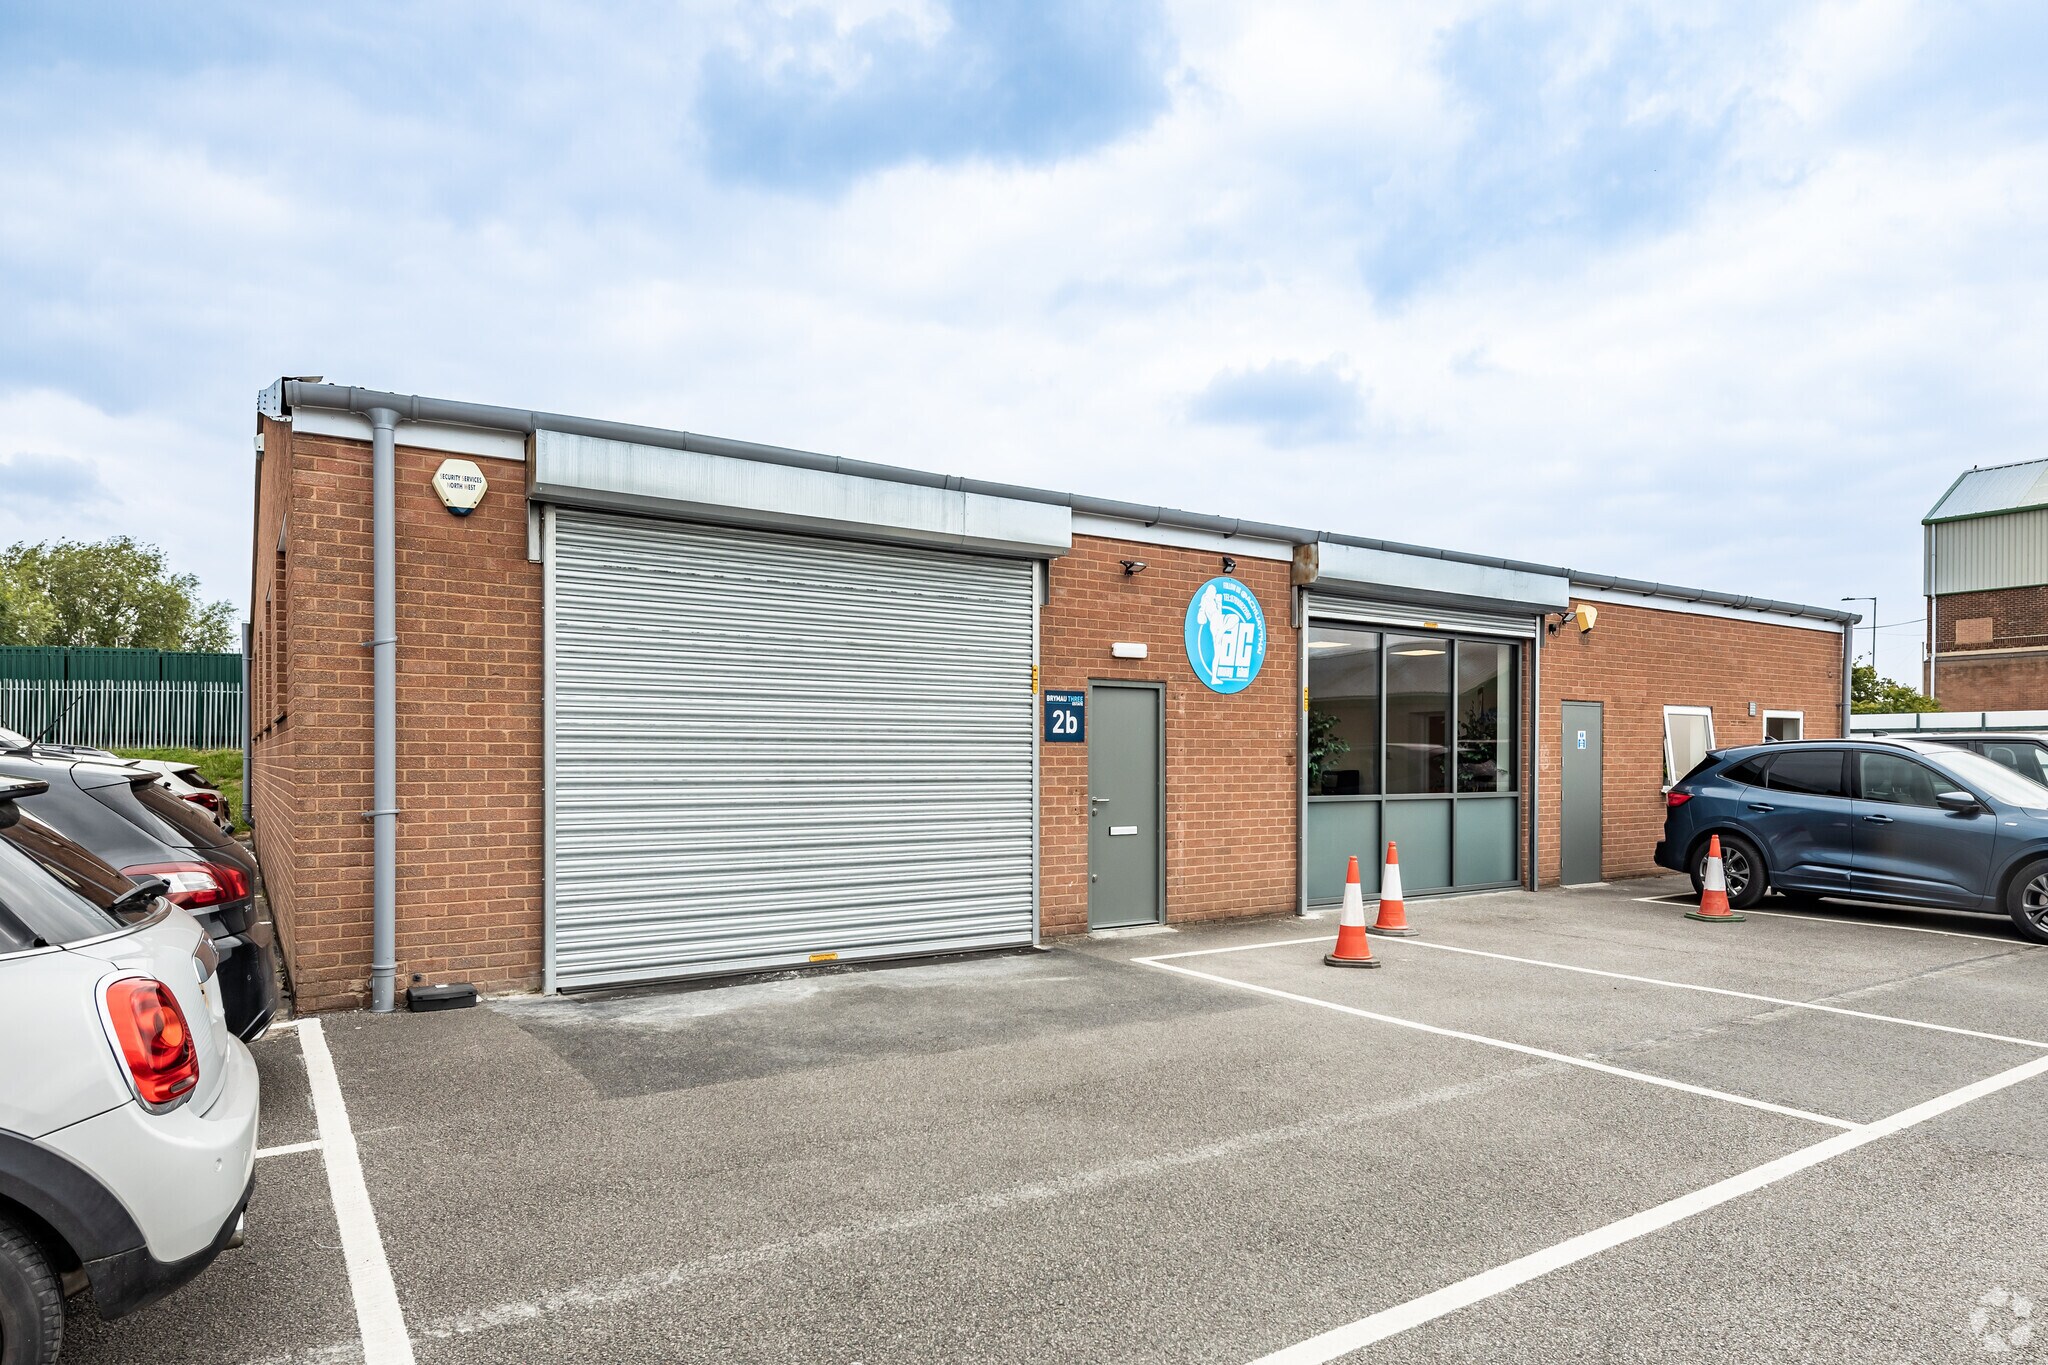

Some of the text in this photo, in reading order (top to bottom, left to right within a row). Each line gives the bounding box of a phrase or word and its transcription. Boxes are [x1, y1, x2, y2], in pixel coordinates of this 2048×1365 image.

[440, 473, 482, 484] SECURITY SERVICES
[447, 482, 463, 490] NORTH
[1068, 695, 1084, 703] THREE
[1052, 709, 1078, 734] 2b
